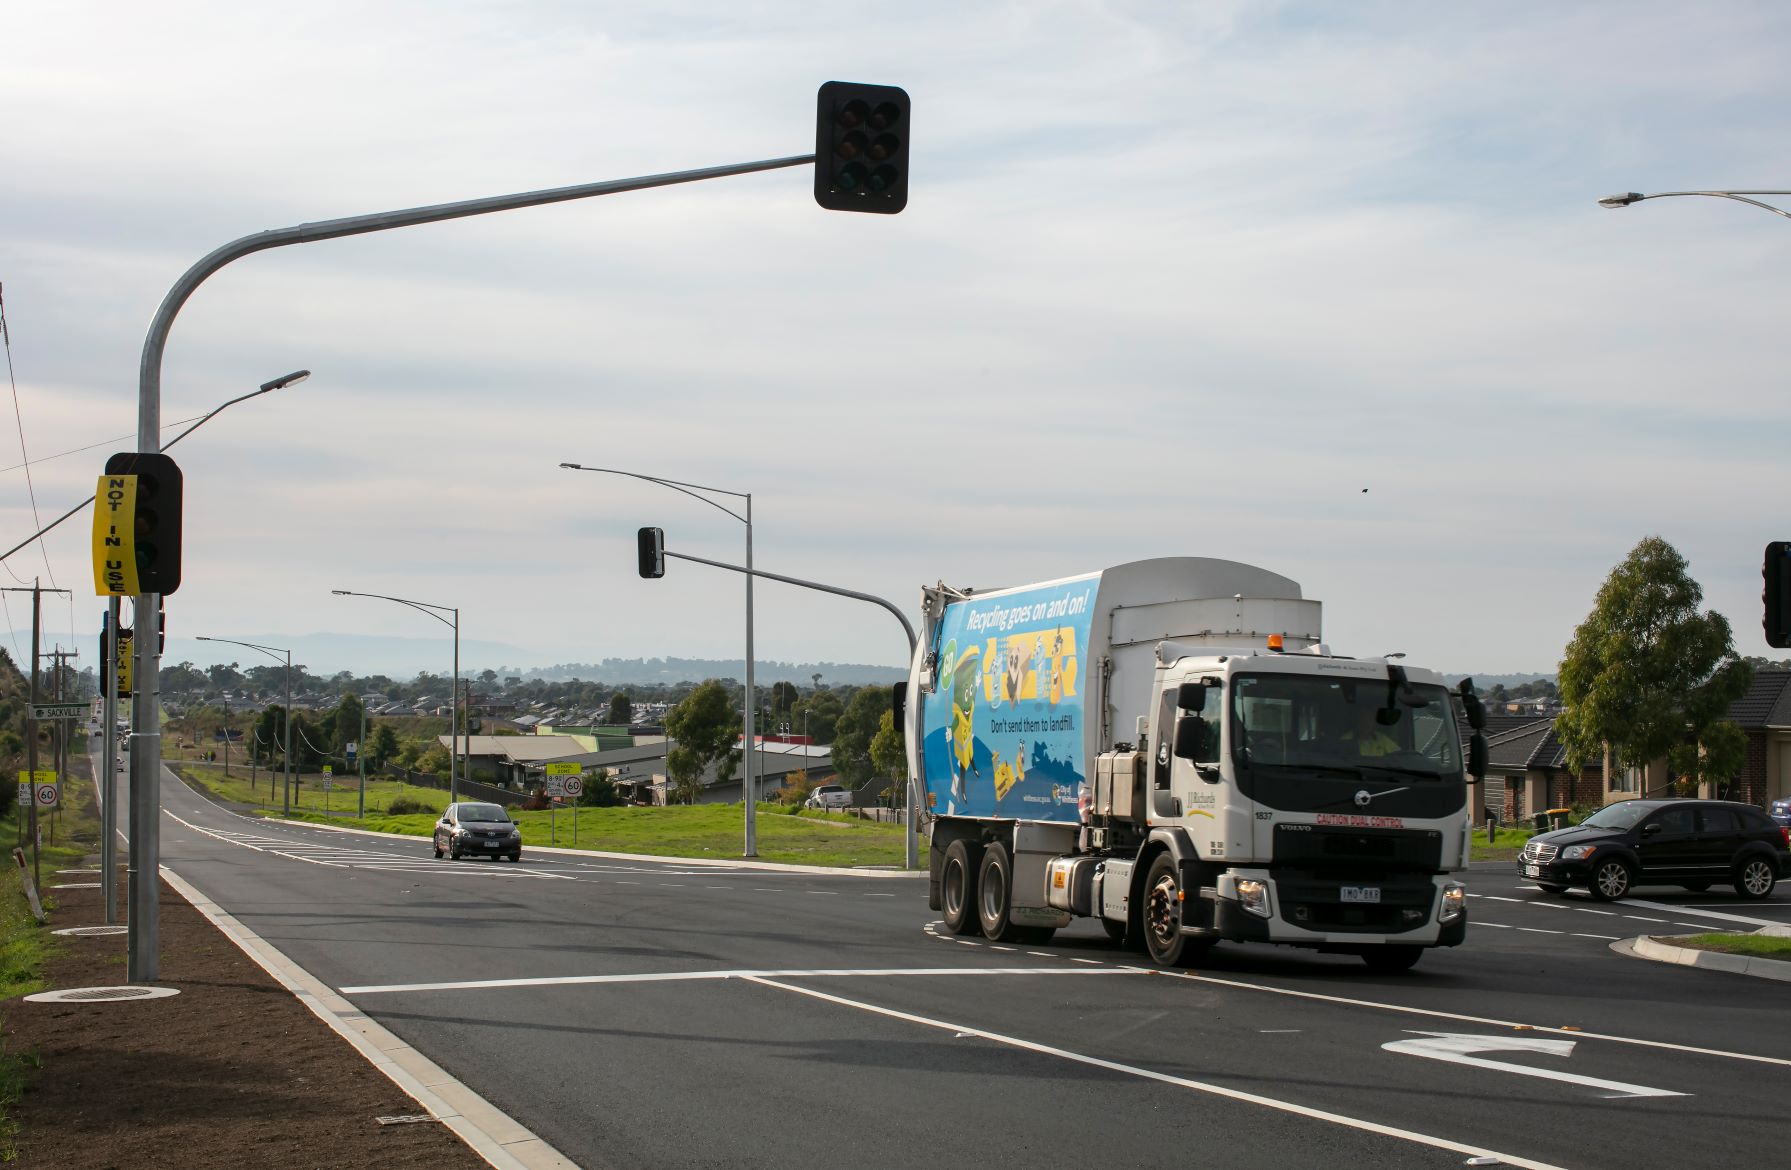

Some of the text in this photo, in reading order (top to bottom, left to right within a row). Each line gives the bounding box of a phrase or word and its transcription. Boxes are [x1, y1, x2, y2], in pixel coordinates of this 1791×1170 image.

[105, 479, 126, 593] NOT IN USE
[967, 588, 1090, 634] Recycling goes on and on!
[943, 651, 954, 677] GO
[47, 708, 82, 718] SACKVILLE
[991, 715, 1075, 734] Don't send them to landfill.
[567, 781, 580, 790] 60
[41, 790, 54, 800] 60
[1280, 824, 1312, 832] VOLVO
[1316, 813, 1404, 829] CAUTION DUAL CONTROL
